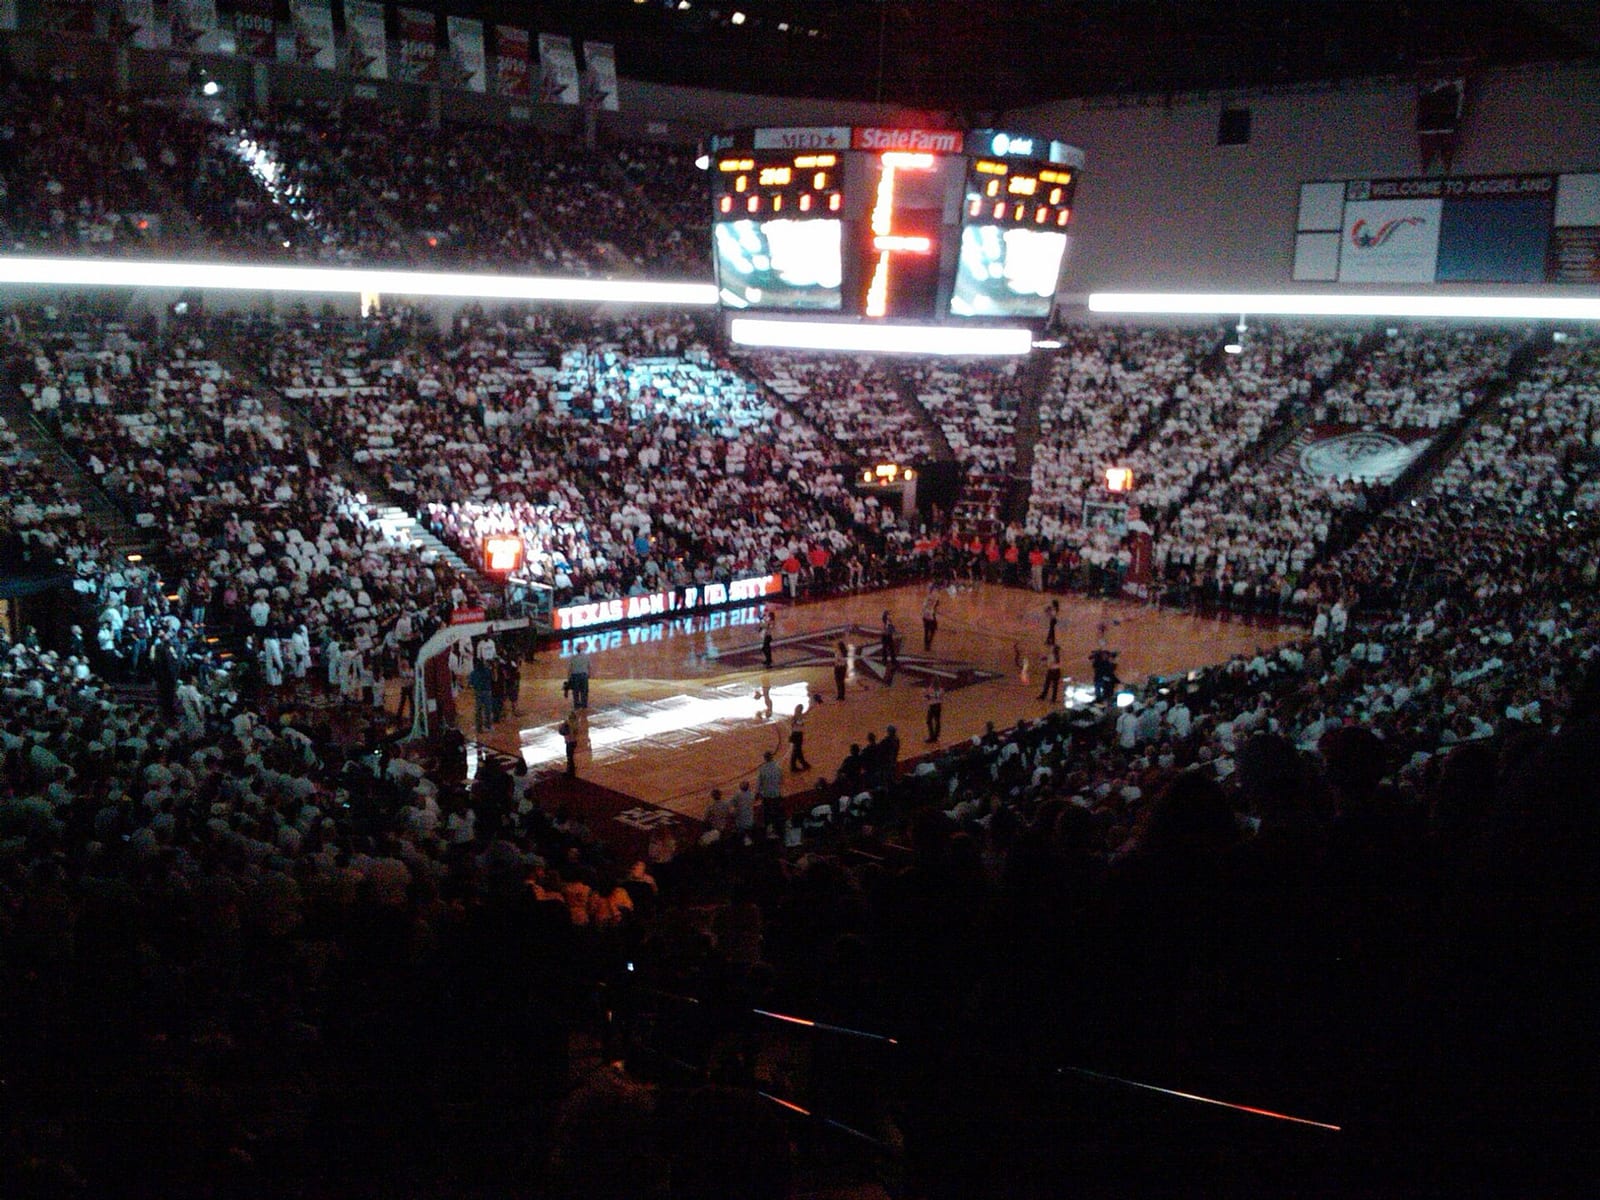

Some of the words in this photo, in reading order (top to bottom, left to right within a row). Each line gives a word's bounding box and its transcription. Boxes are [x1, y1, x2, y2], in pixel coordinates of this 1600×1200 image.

[1373, 181, 1440, 196] WELCOME
[1446, 180, 1465, 195] TO
[557, 600, 624, 630] TEXAS
